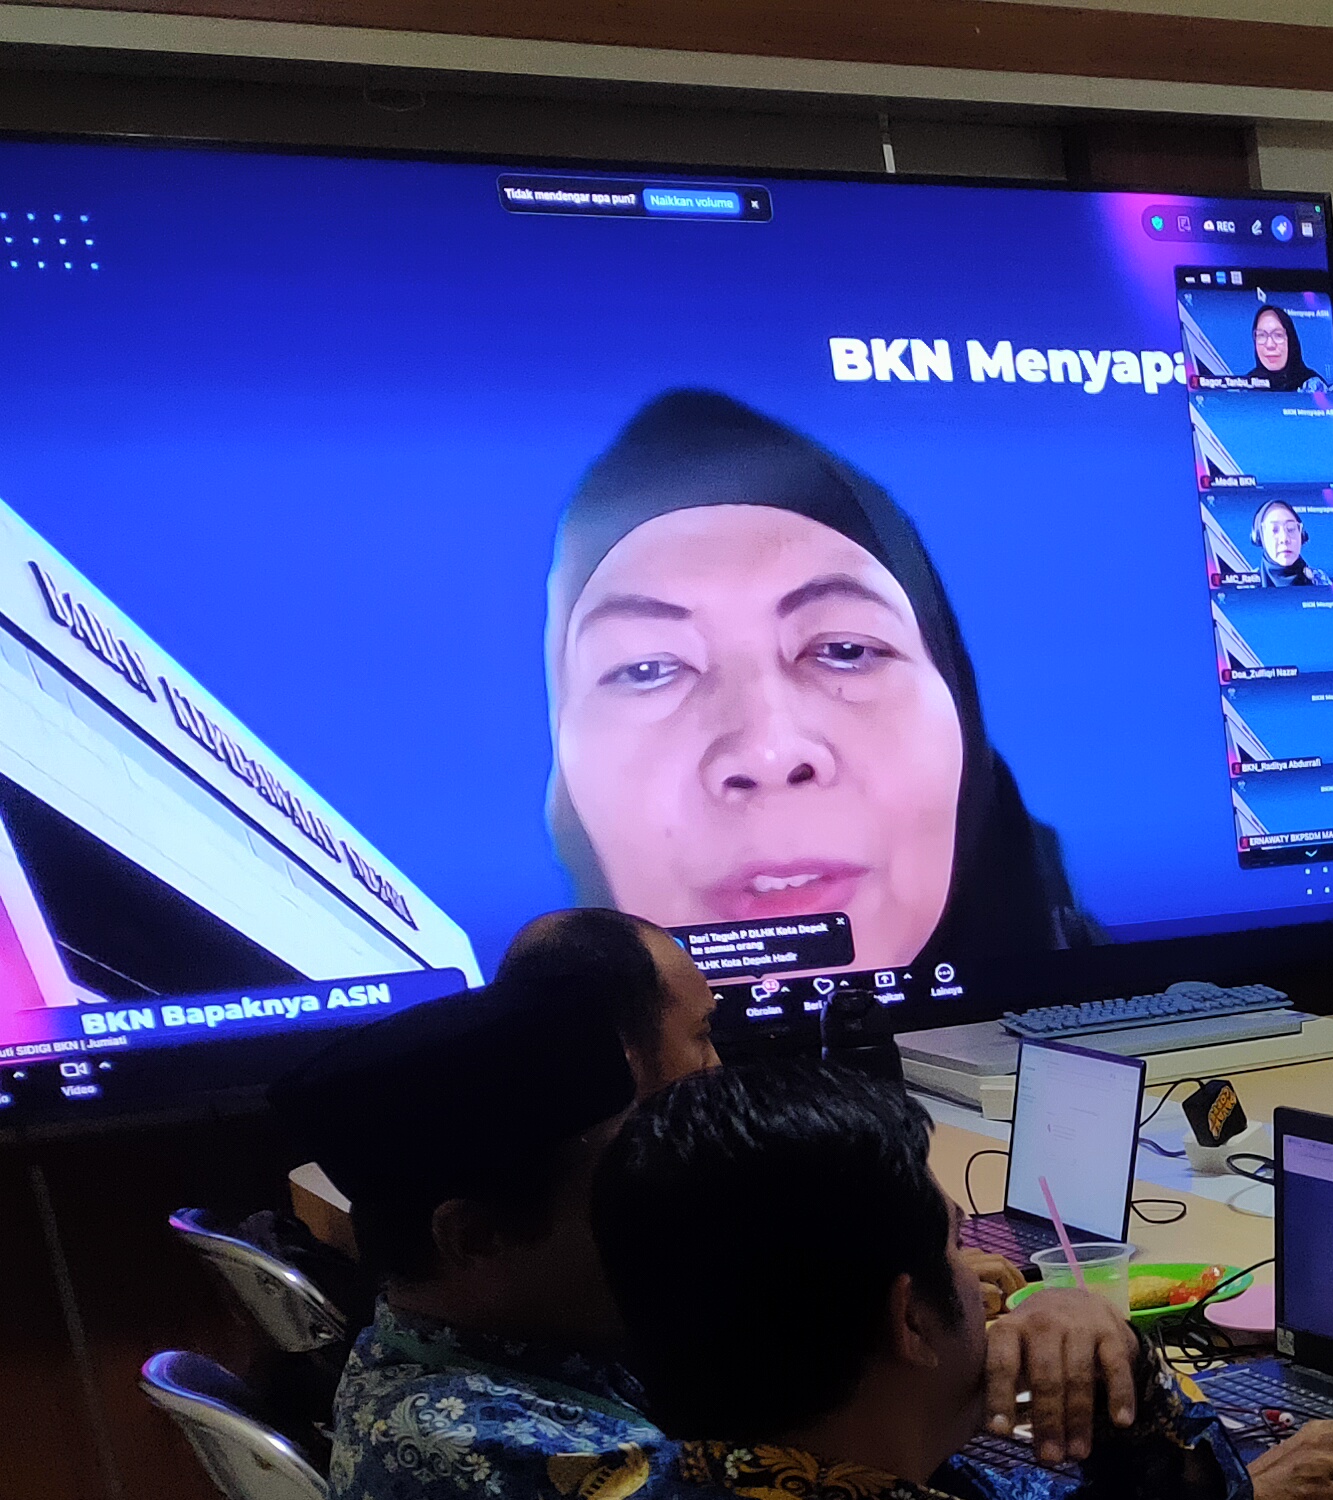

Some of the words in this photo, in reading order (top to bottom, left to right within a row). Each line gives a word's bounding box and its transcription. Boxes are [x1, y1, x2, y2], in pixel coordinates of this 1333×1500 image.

[504, 188, 533, 200] Tidak
[535, 190, 590, 204] mendengar
[592, 194, 610, 205] apa
[612, 193, 636, 205] pun?
[650, 194, 693, 208] Naikkan
[695, 196, 734, 209] volume
[1216, 221, 1236, 233] REC
[829, 336, 954, 383] BKN
[689, 933, 710, 944] Dari
[775, 926, 798, 936] Kota
[798, 923, 829, 934] Depok
[704, 943, 736, 954] semua
[736, 941, 765, 952] orang
[721, 958, 743, 968] Kota
[742, 954, 772, 966] Depok
[930, 985, 963, 997] Lainnya
[81, 1007, 156, 1036] BKN
[161, 990, 321, 1028] Bapaknya
[326, 982, 392, 1010] ASN
[745, 1006, 782, 1017] Obrolan
[53, 1040, 79, 1052] BKN
[60, 1085, 98, 1097] Video
